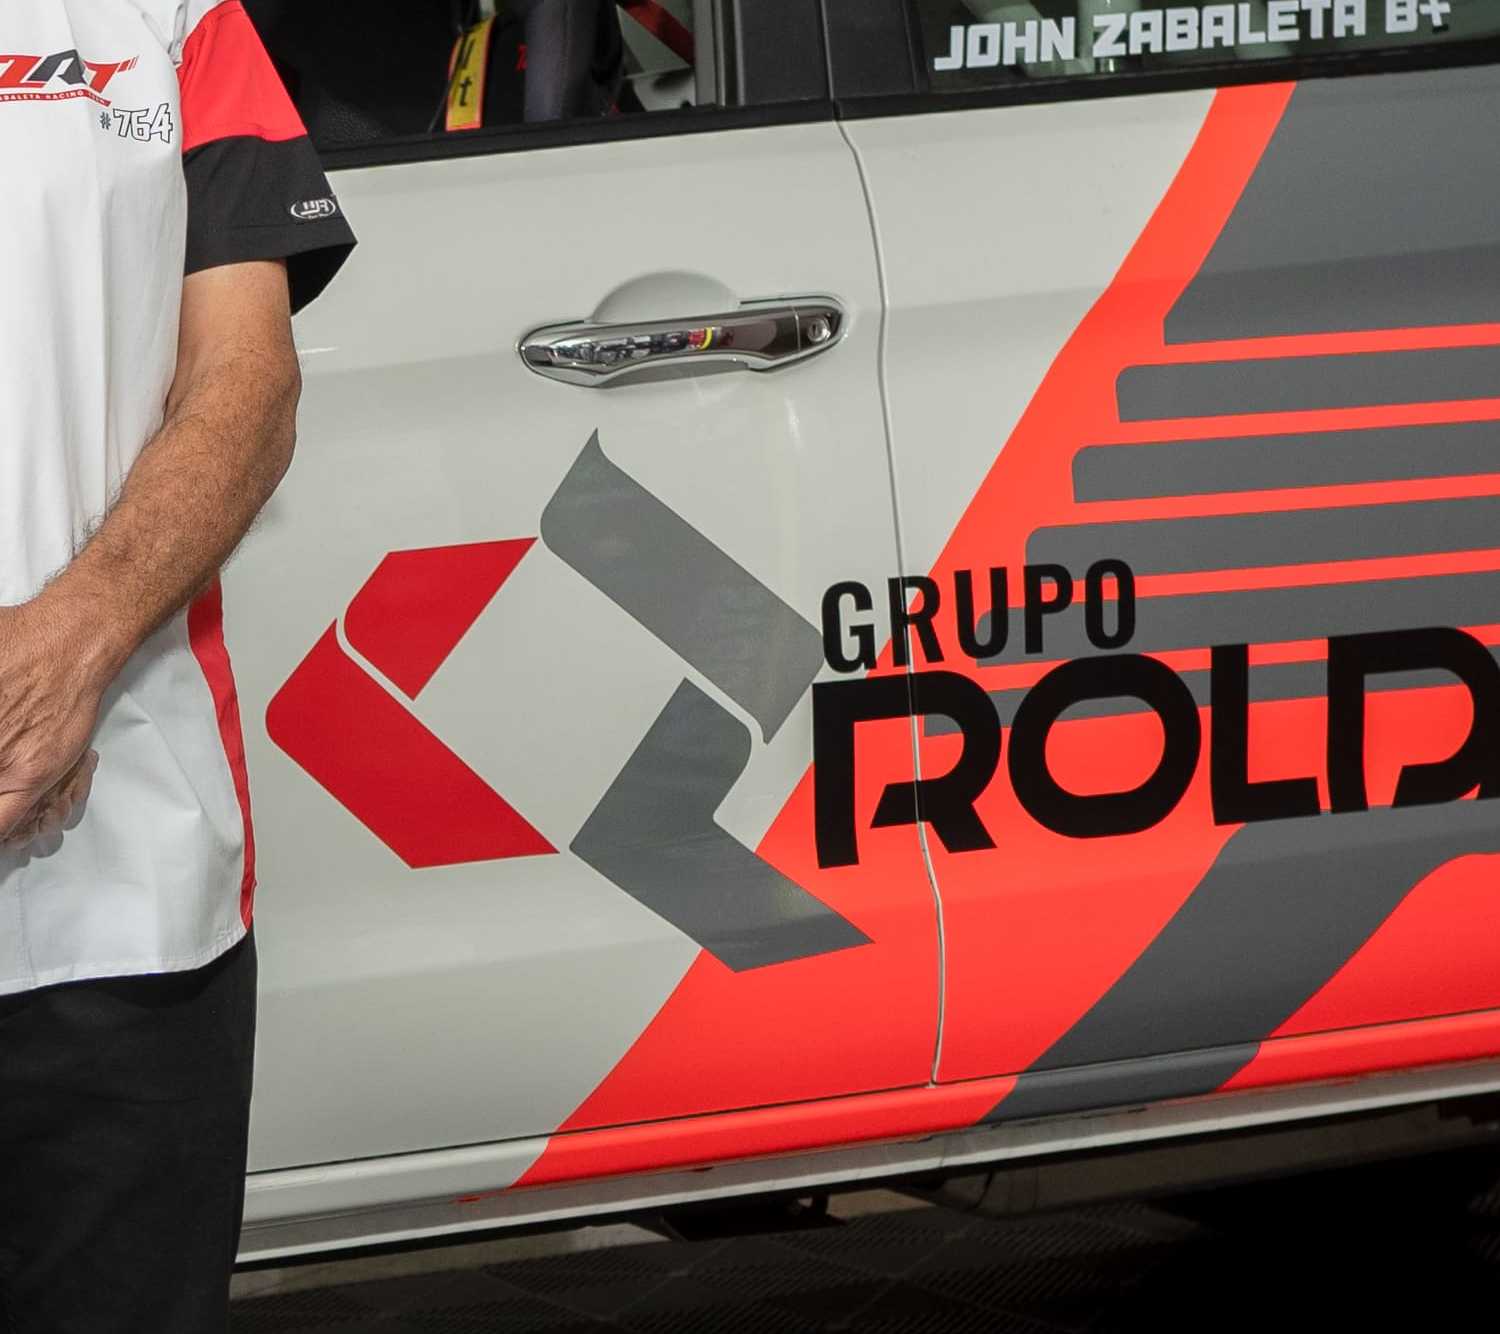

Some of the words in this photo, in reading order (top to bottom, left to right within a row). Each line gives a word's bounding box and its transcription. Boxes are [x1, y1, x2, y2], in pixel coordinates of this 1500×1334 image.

[934, 15, 1076, 72] JOHN
[45, 90, 84, 101] RACING
[821, 557, 1137, 674] GRUPO
